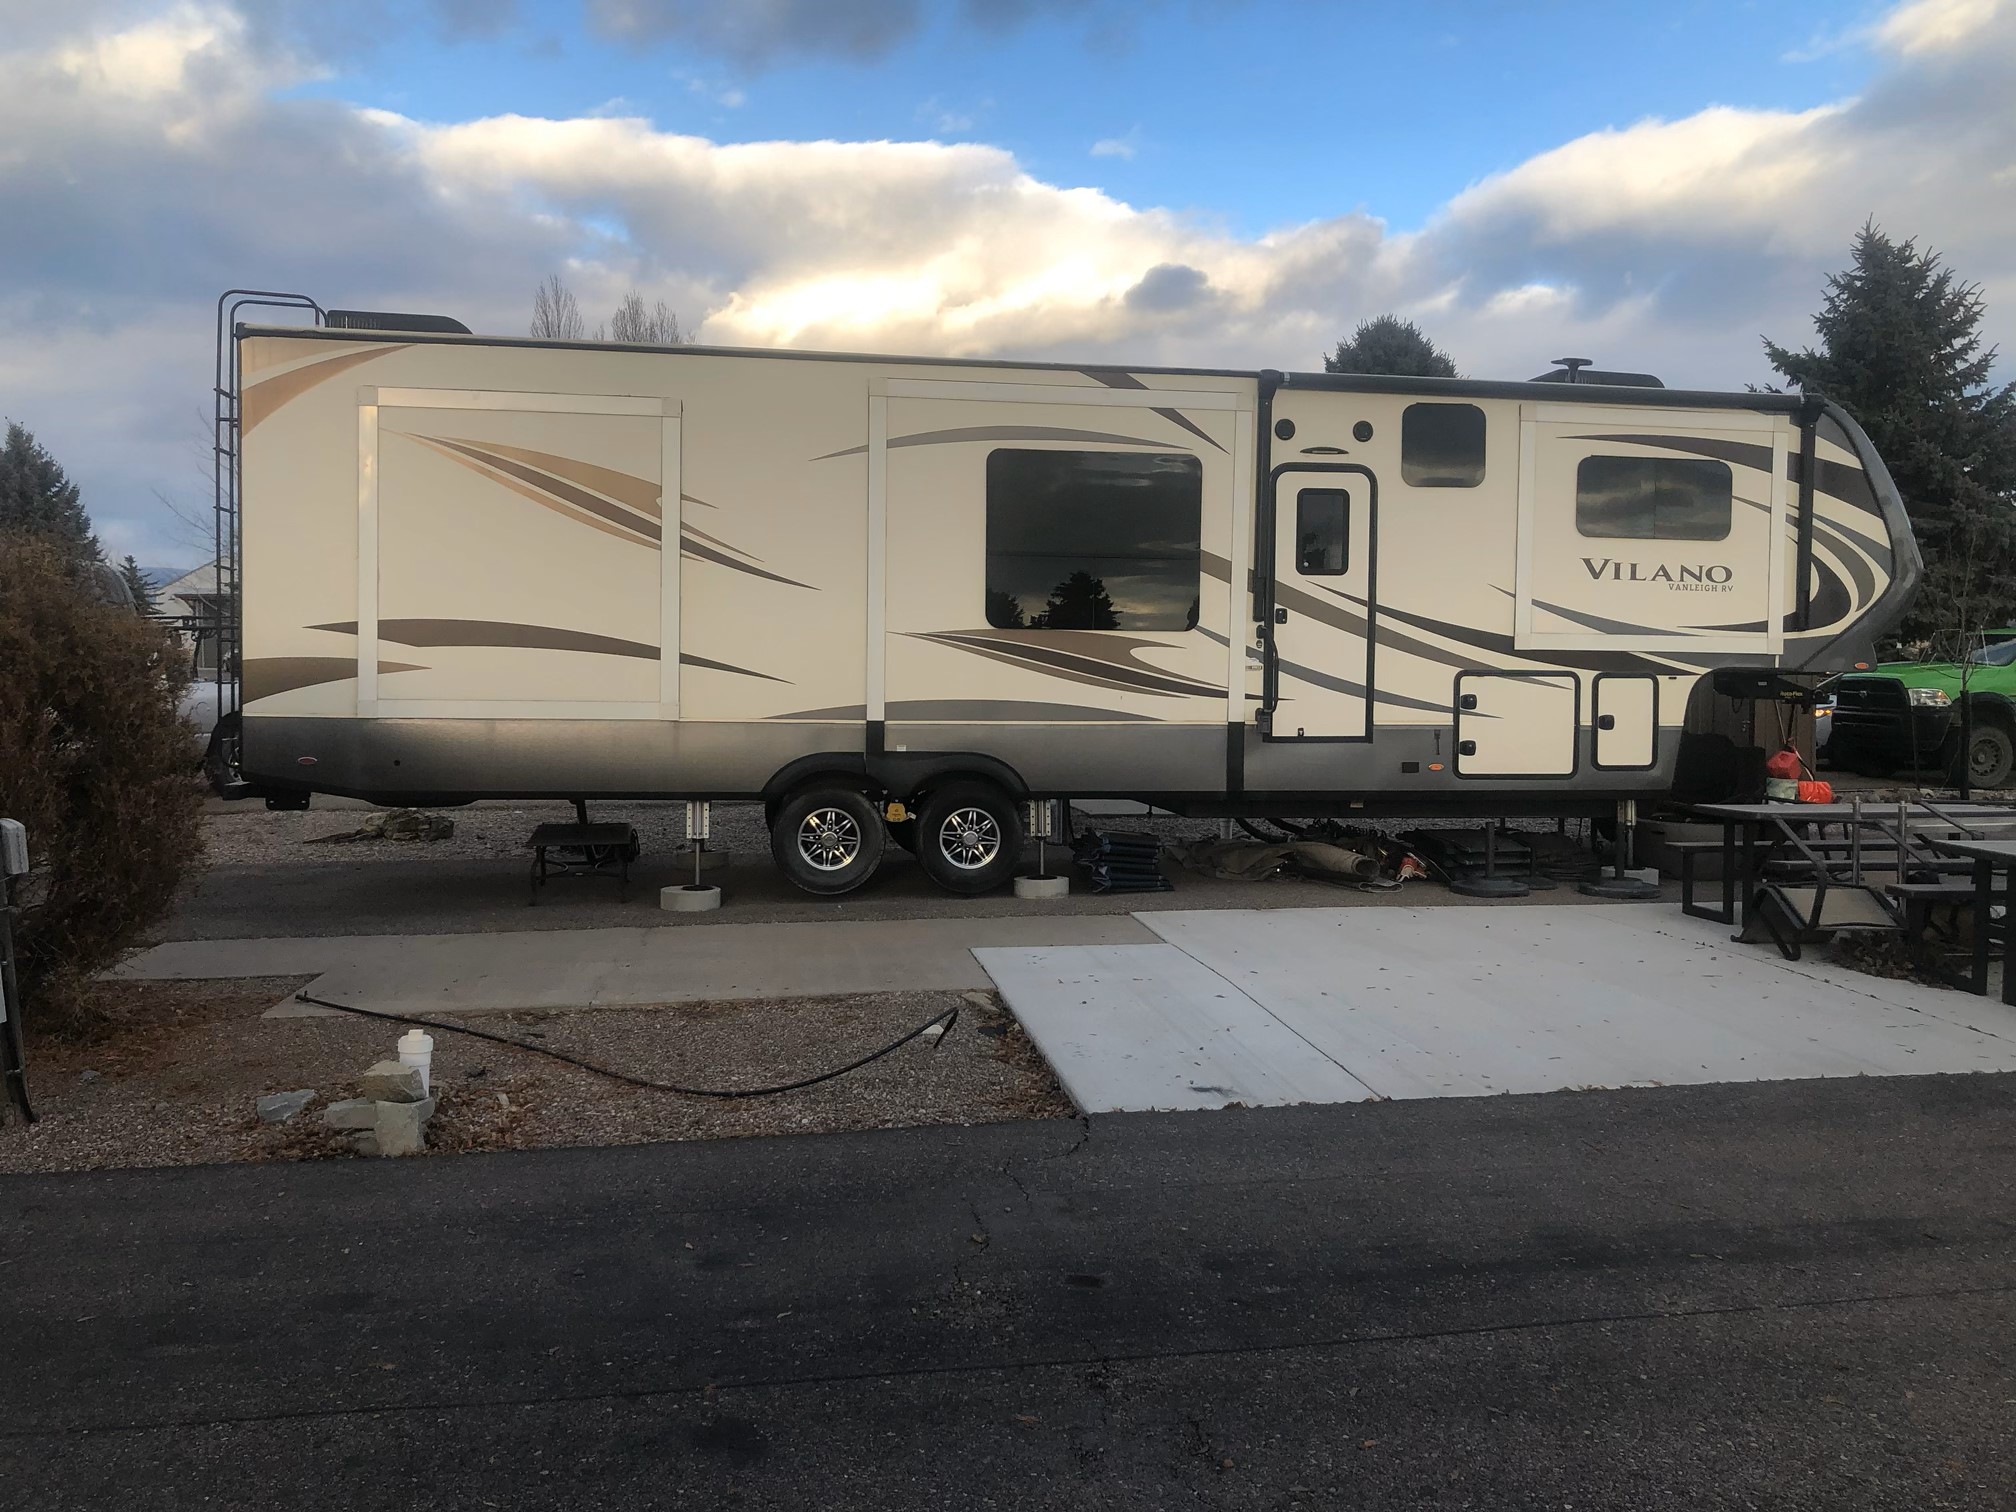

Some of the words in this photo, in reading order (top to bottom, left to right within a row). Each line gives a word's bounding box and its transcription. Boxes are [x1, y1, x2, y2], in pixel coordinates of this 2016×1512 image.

[1580, 557, 1733, 584] VILANO
[1668, 583, 1718, 592] VANLEIGH
[1721, 584, 1734, 593] RV
